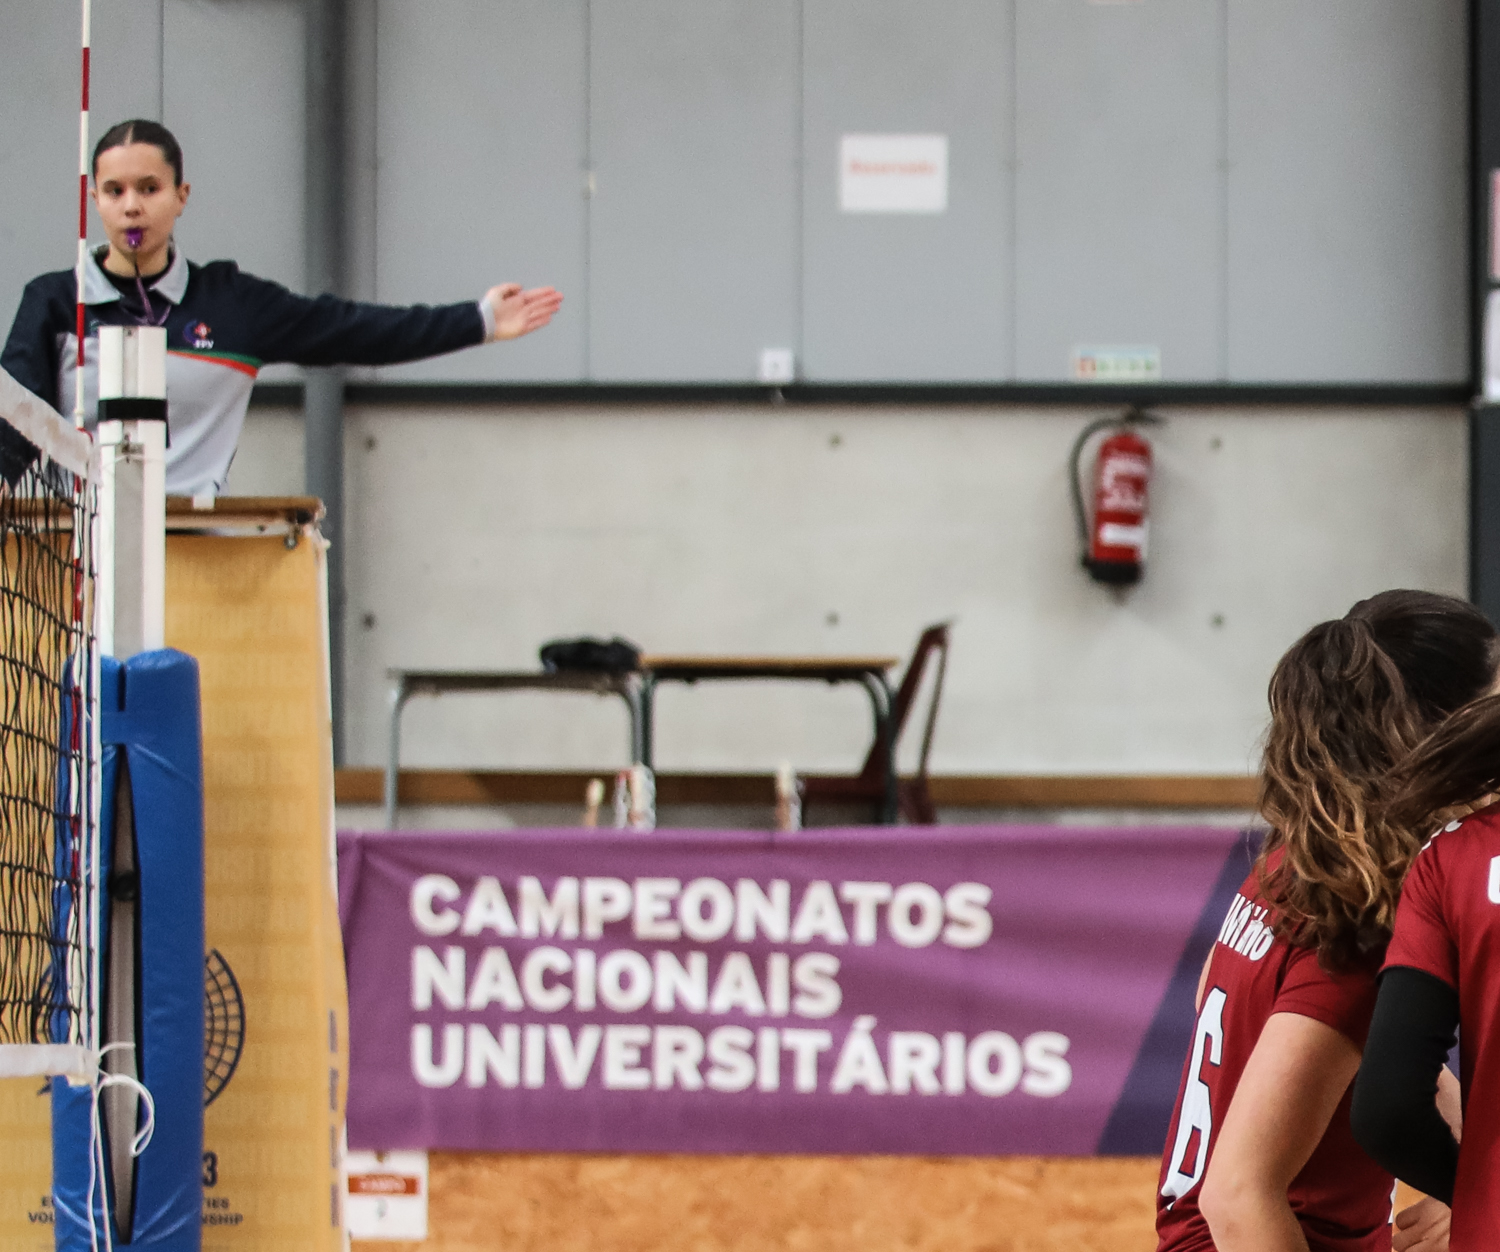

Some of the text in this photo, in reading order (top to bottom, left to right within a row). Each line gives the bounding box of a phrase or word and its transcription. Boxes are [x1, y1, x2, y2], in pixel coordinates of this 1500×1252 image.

[411, 874, 994, 949] CAMPEONATOS
[411, 946, 843, 1018] NACIONAIS
[411, 1017, 1073, 1097] UNIVERSITÁRIOS
[1160, 987, 1227, 1209] 6
